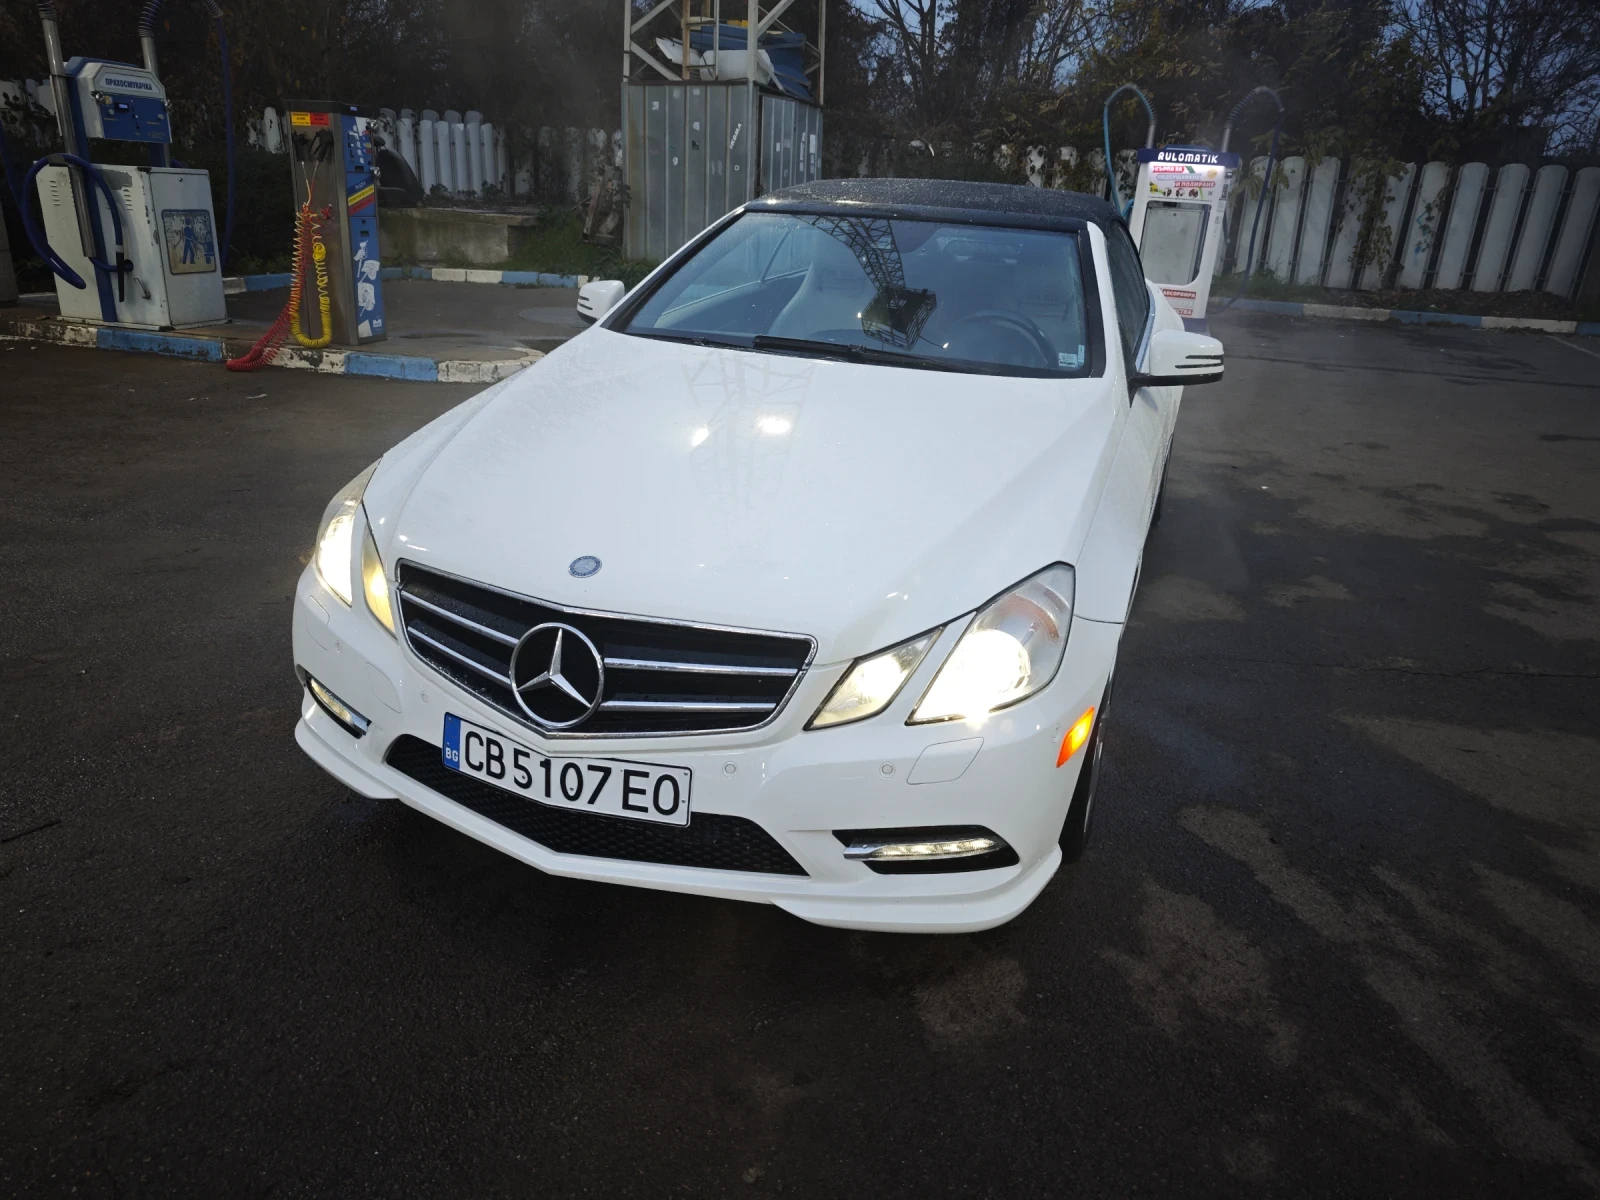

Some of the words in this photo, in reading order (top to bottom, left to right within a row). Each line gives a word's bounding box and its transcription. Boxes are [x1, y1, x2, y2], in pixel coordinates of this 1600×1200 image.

[105, 78, 153, 91] ПРАХОСМУКАЧКА
[1158, 152, 1218, 164] RULOMATIK
[1163, 290, 1196, 298] АБСОРБИРА
[445, 747, 459, 762] BG
